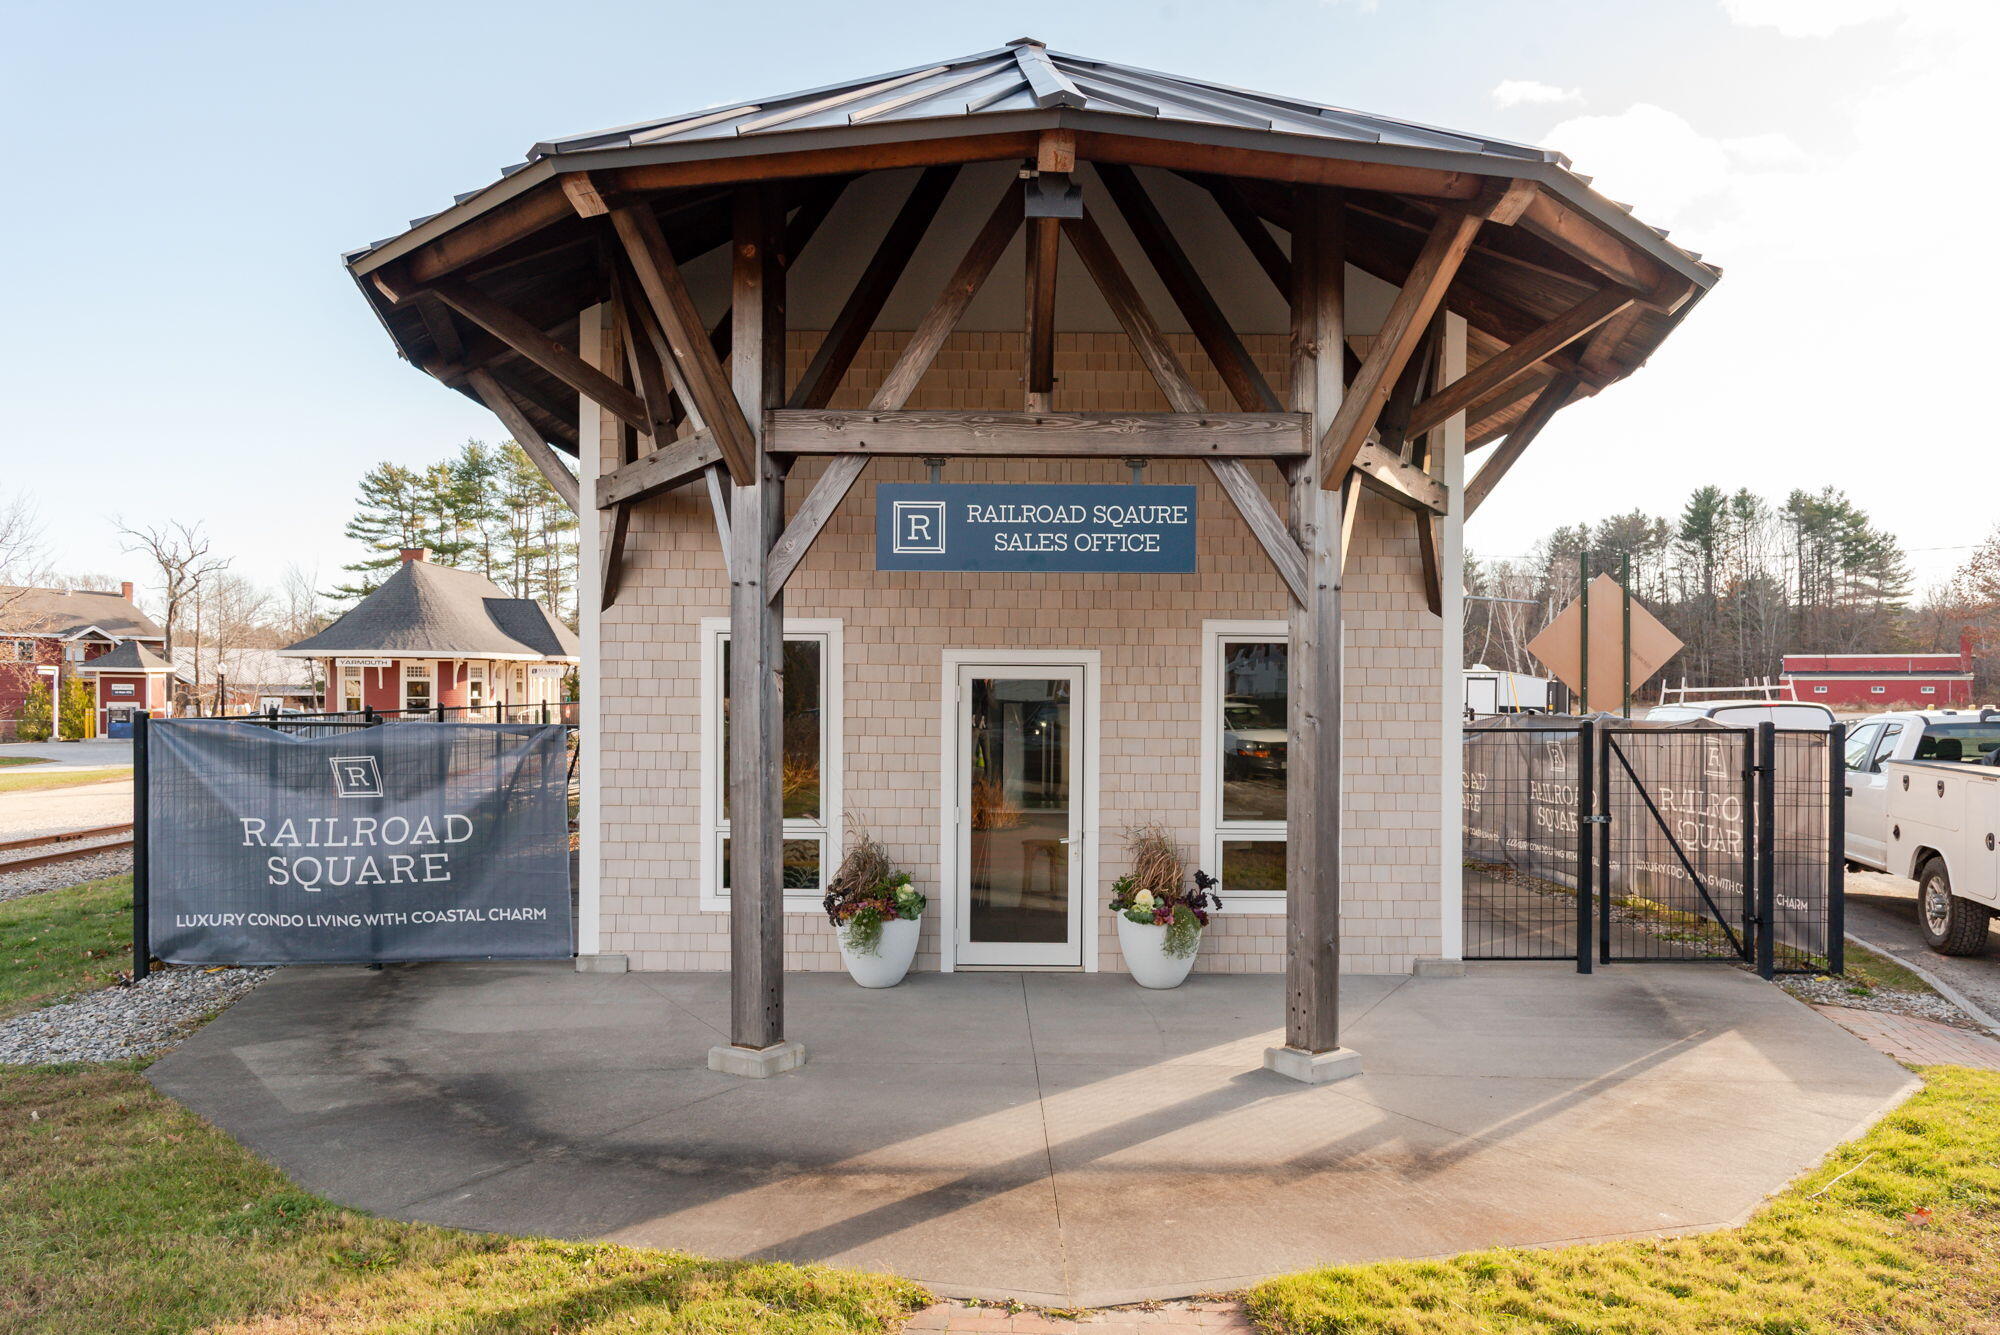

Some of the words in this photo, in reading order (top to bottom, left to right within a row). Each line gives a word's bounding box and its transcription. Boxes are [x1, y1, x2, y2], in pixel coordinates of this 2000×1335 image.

[967, 504, 1087, 524] RAILROAD
[1093, 505, 1188, 527] SQAURE
[907, 514, 932, 541] R
[994, 533, 1068, 552] SALES
[1074, 533, 1160, 553] OFFICE
[344, 766, 370, 787] R
[240, 814, 474, 848] RAILROAD
[1537, 806, 1579, 833] SQUAR
[268, 852, 452, 893] SQUARE
[1776, 893, 1809, 911] CHARM
[176, 913, 246, 928] LUXURY
[248, 913, 304, 927] CONDO
[307, 913, 362, 927] LIVING
[363, 912, 407, 927] WITH
[411, 909, 486, 924] COASTAL
[488, 907, 547, 921] CHARM
